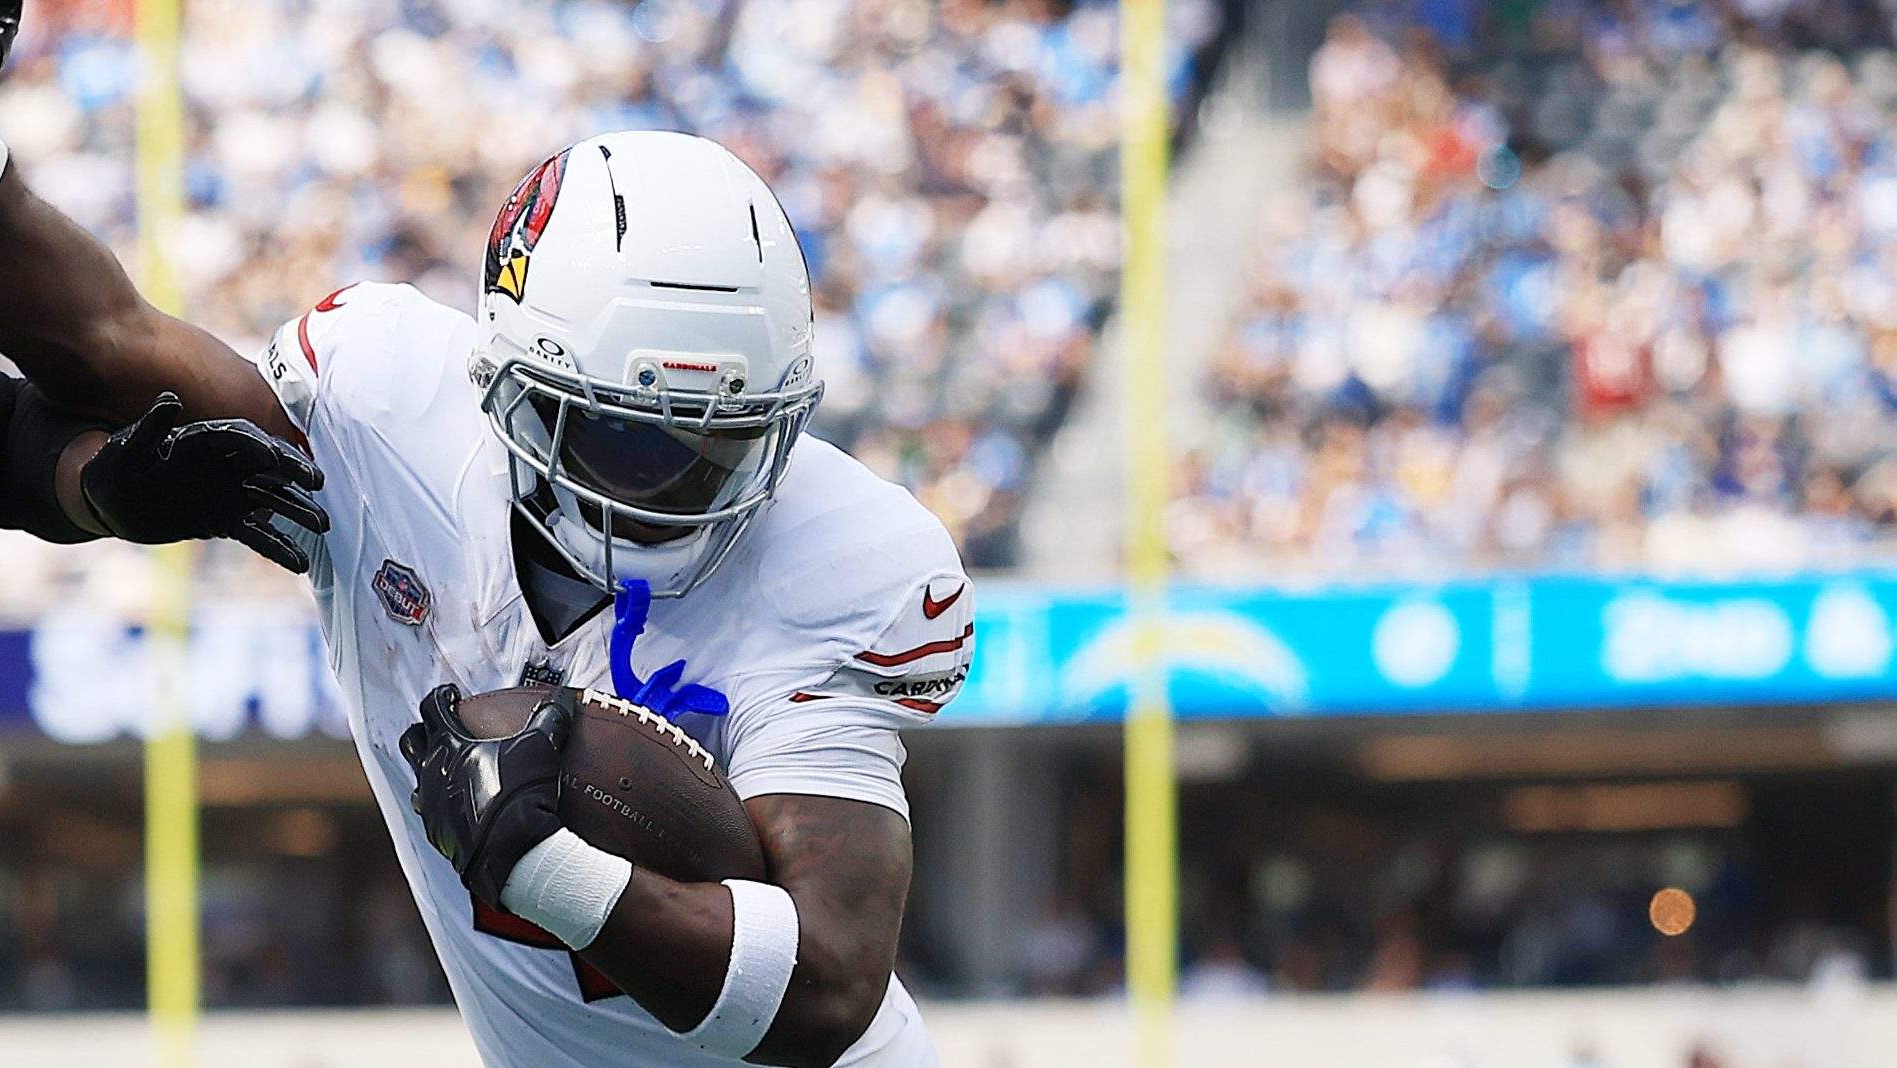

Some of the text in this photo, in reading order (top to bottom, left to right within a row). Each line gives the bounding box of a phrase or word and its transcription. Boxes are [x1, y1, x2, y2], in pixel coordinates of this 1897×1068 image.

[529, 345, 570, 369] OAKLEY
[379, 577, 424, 617] DEBUT
[583, 784, 654, 832] FOOTBALL
